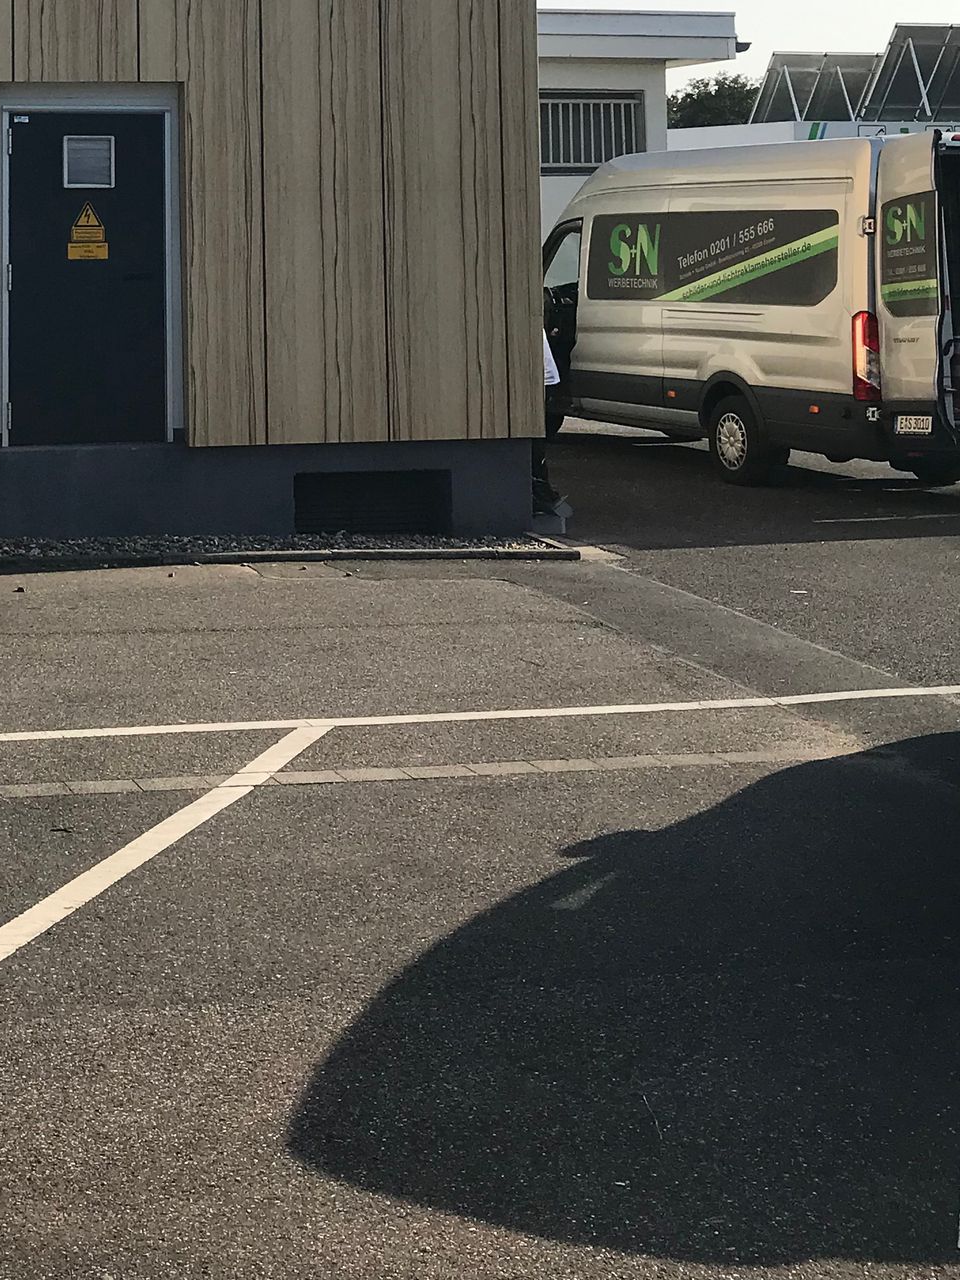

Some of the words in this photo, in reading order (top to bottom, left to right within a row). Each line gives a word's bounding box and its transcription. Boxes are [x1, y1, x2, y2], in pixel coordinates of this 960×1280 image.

[607, 223, 661, 276] S+N
[677, 249, 709, 269] Telefon
[710, 236, 730, 256] 0201
[739, 225, 756, 244] 555
[757, 218, 775, 236] 666
[607, 277, 658, 289] WERBETECHNIK
